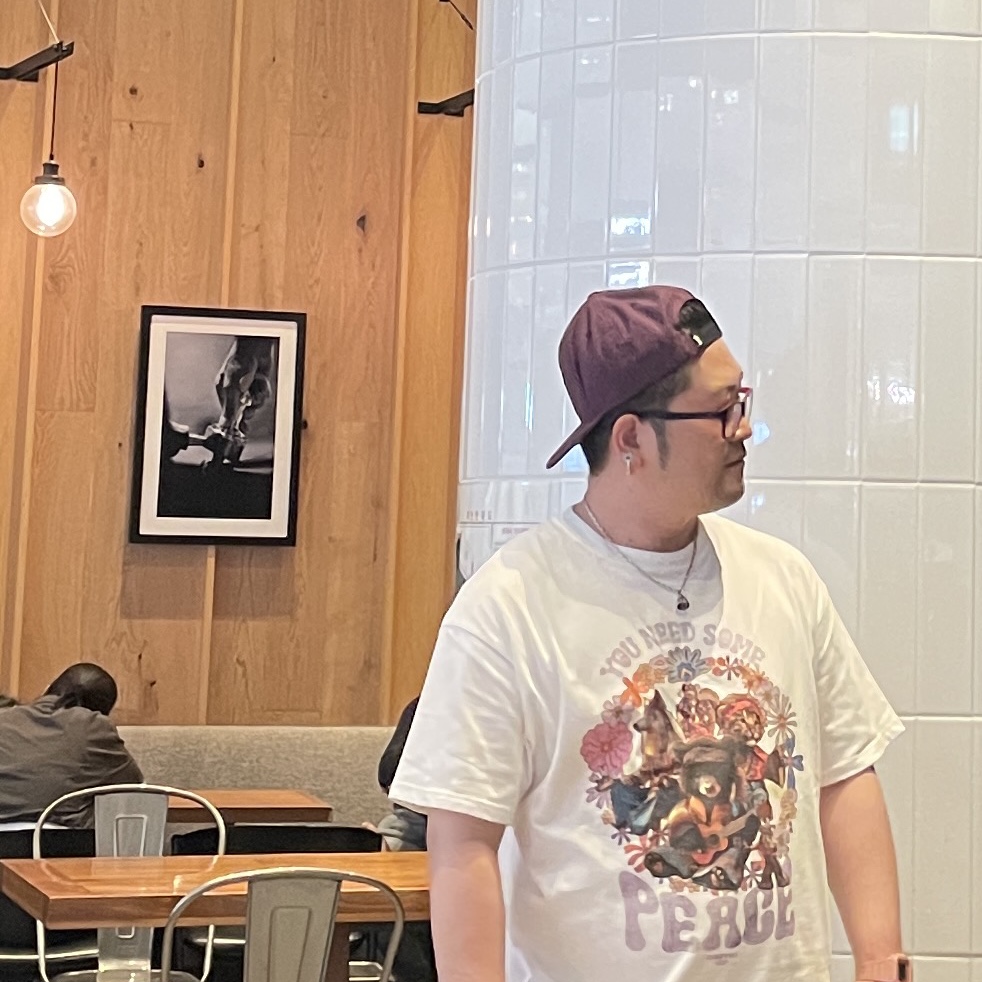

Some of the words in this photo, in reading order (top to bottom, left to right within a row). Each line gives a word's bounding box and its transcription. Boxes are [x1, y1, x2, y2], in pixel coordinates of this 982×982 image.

[600, 636, 642, 678] YOU
[638, 621, 696, 651] NEED
[618, 870, 796, 953] PEACE
